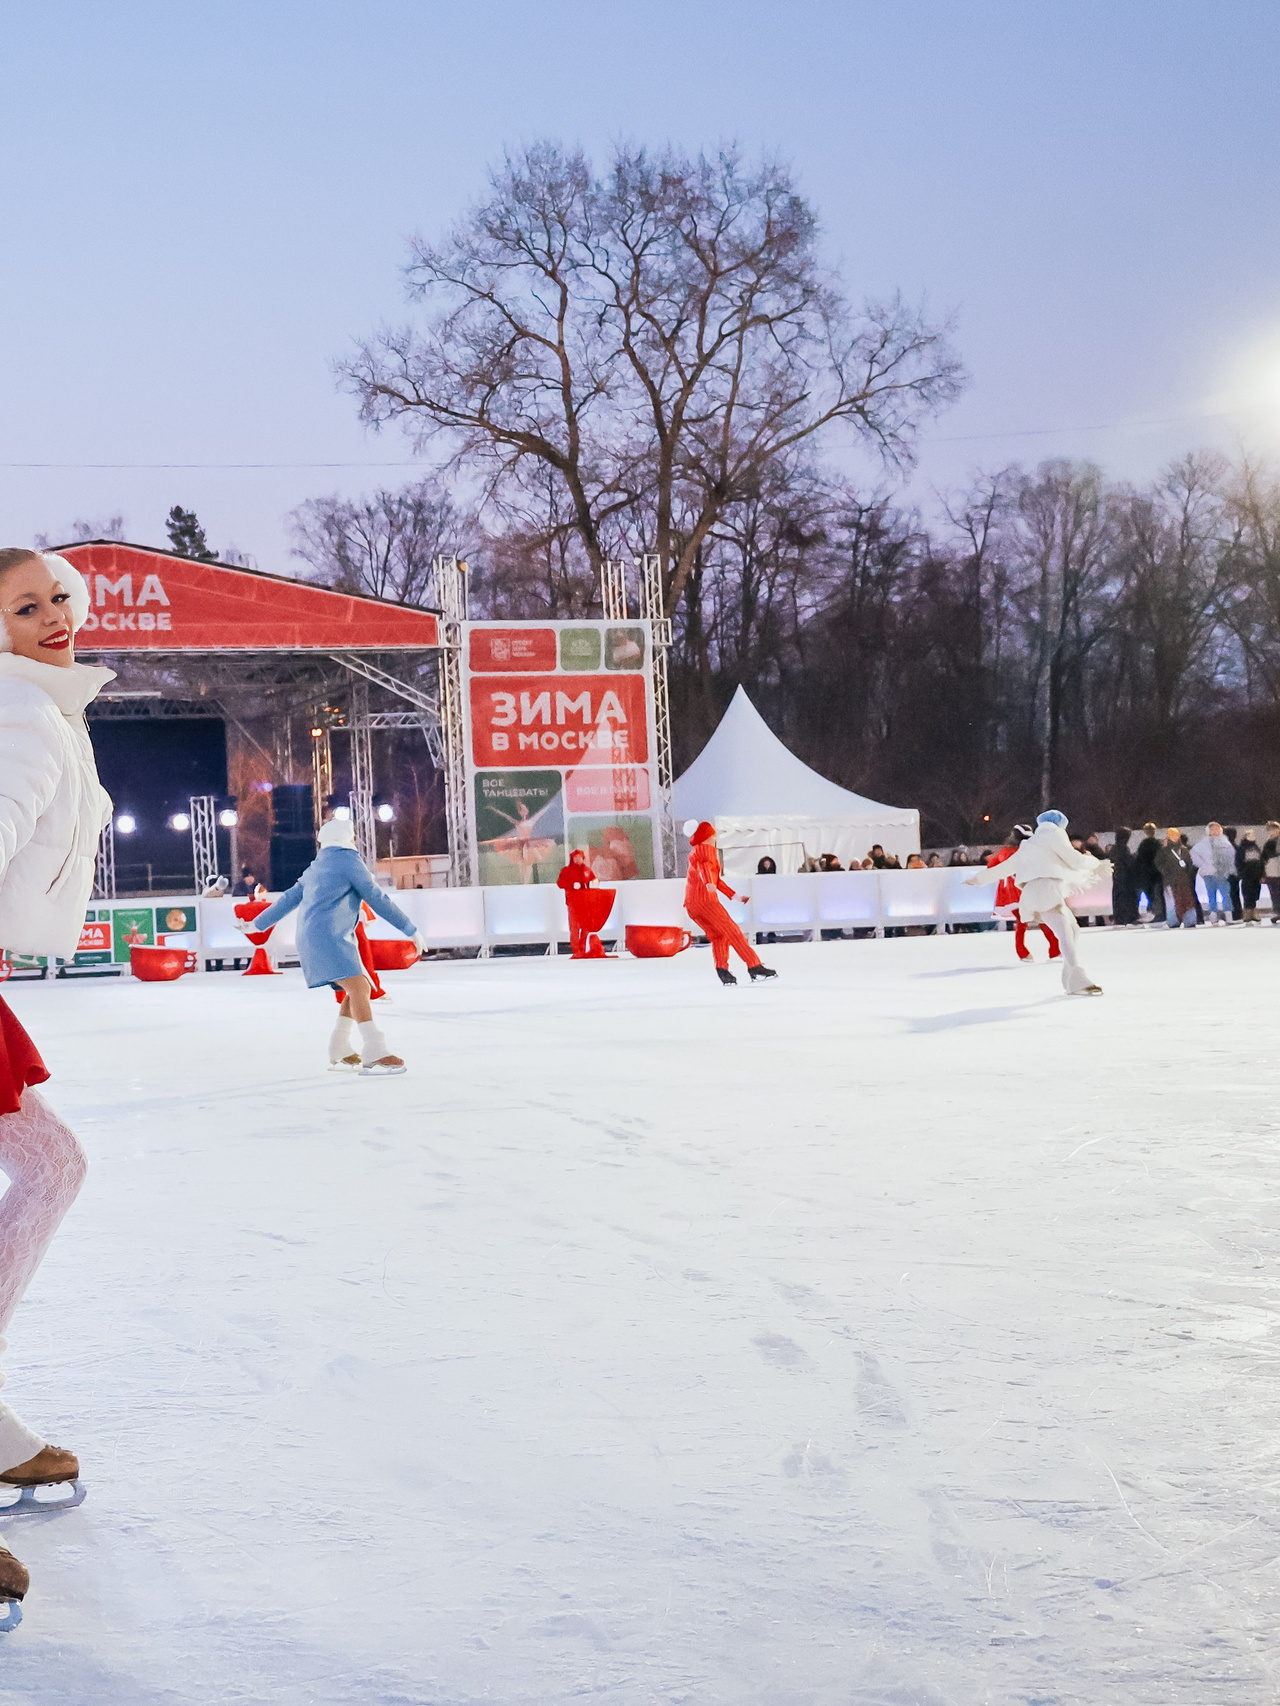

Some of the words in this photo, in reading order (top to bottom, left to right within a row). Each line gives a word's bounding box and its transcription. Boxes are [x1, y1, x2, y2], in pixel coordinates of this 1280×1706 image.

[82, 574, 170, 606] МА
[81, 612, 172, 631] ОСКВЕ
[491, 691, 627, 726] ЗИМА
[492, 732, 509, 750] В
[519, 730, 629, 750] МОСКВЕ
